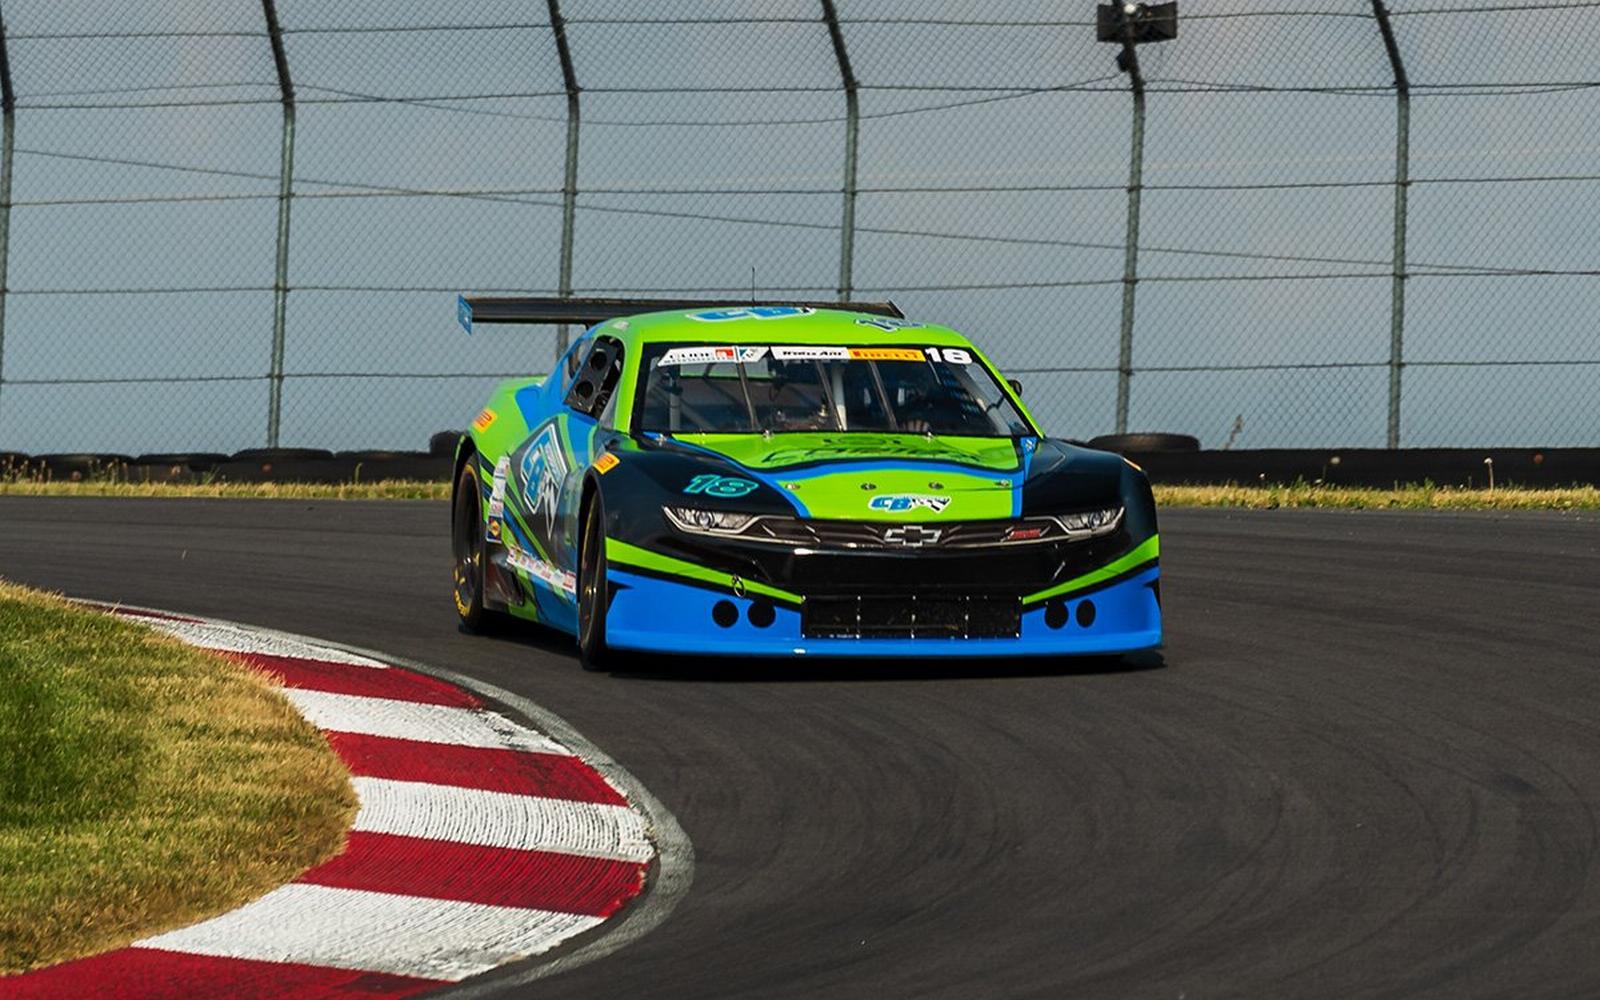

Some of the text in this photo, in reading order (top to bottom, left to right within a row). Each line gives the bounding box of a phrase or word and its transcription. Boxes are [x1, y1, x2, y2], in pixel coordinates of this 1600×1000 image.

[925, 347, 972, 364] 18
[683, 474, 759, 498] 18
[870, 496, 912, 511] CB
